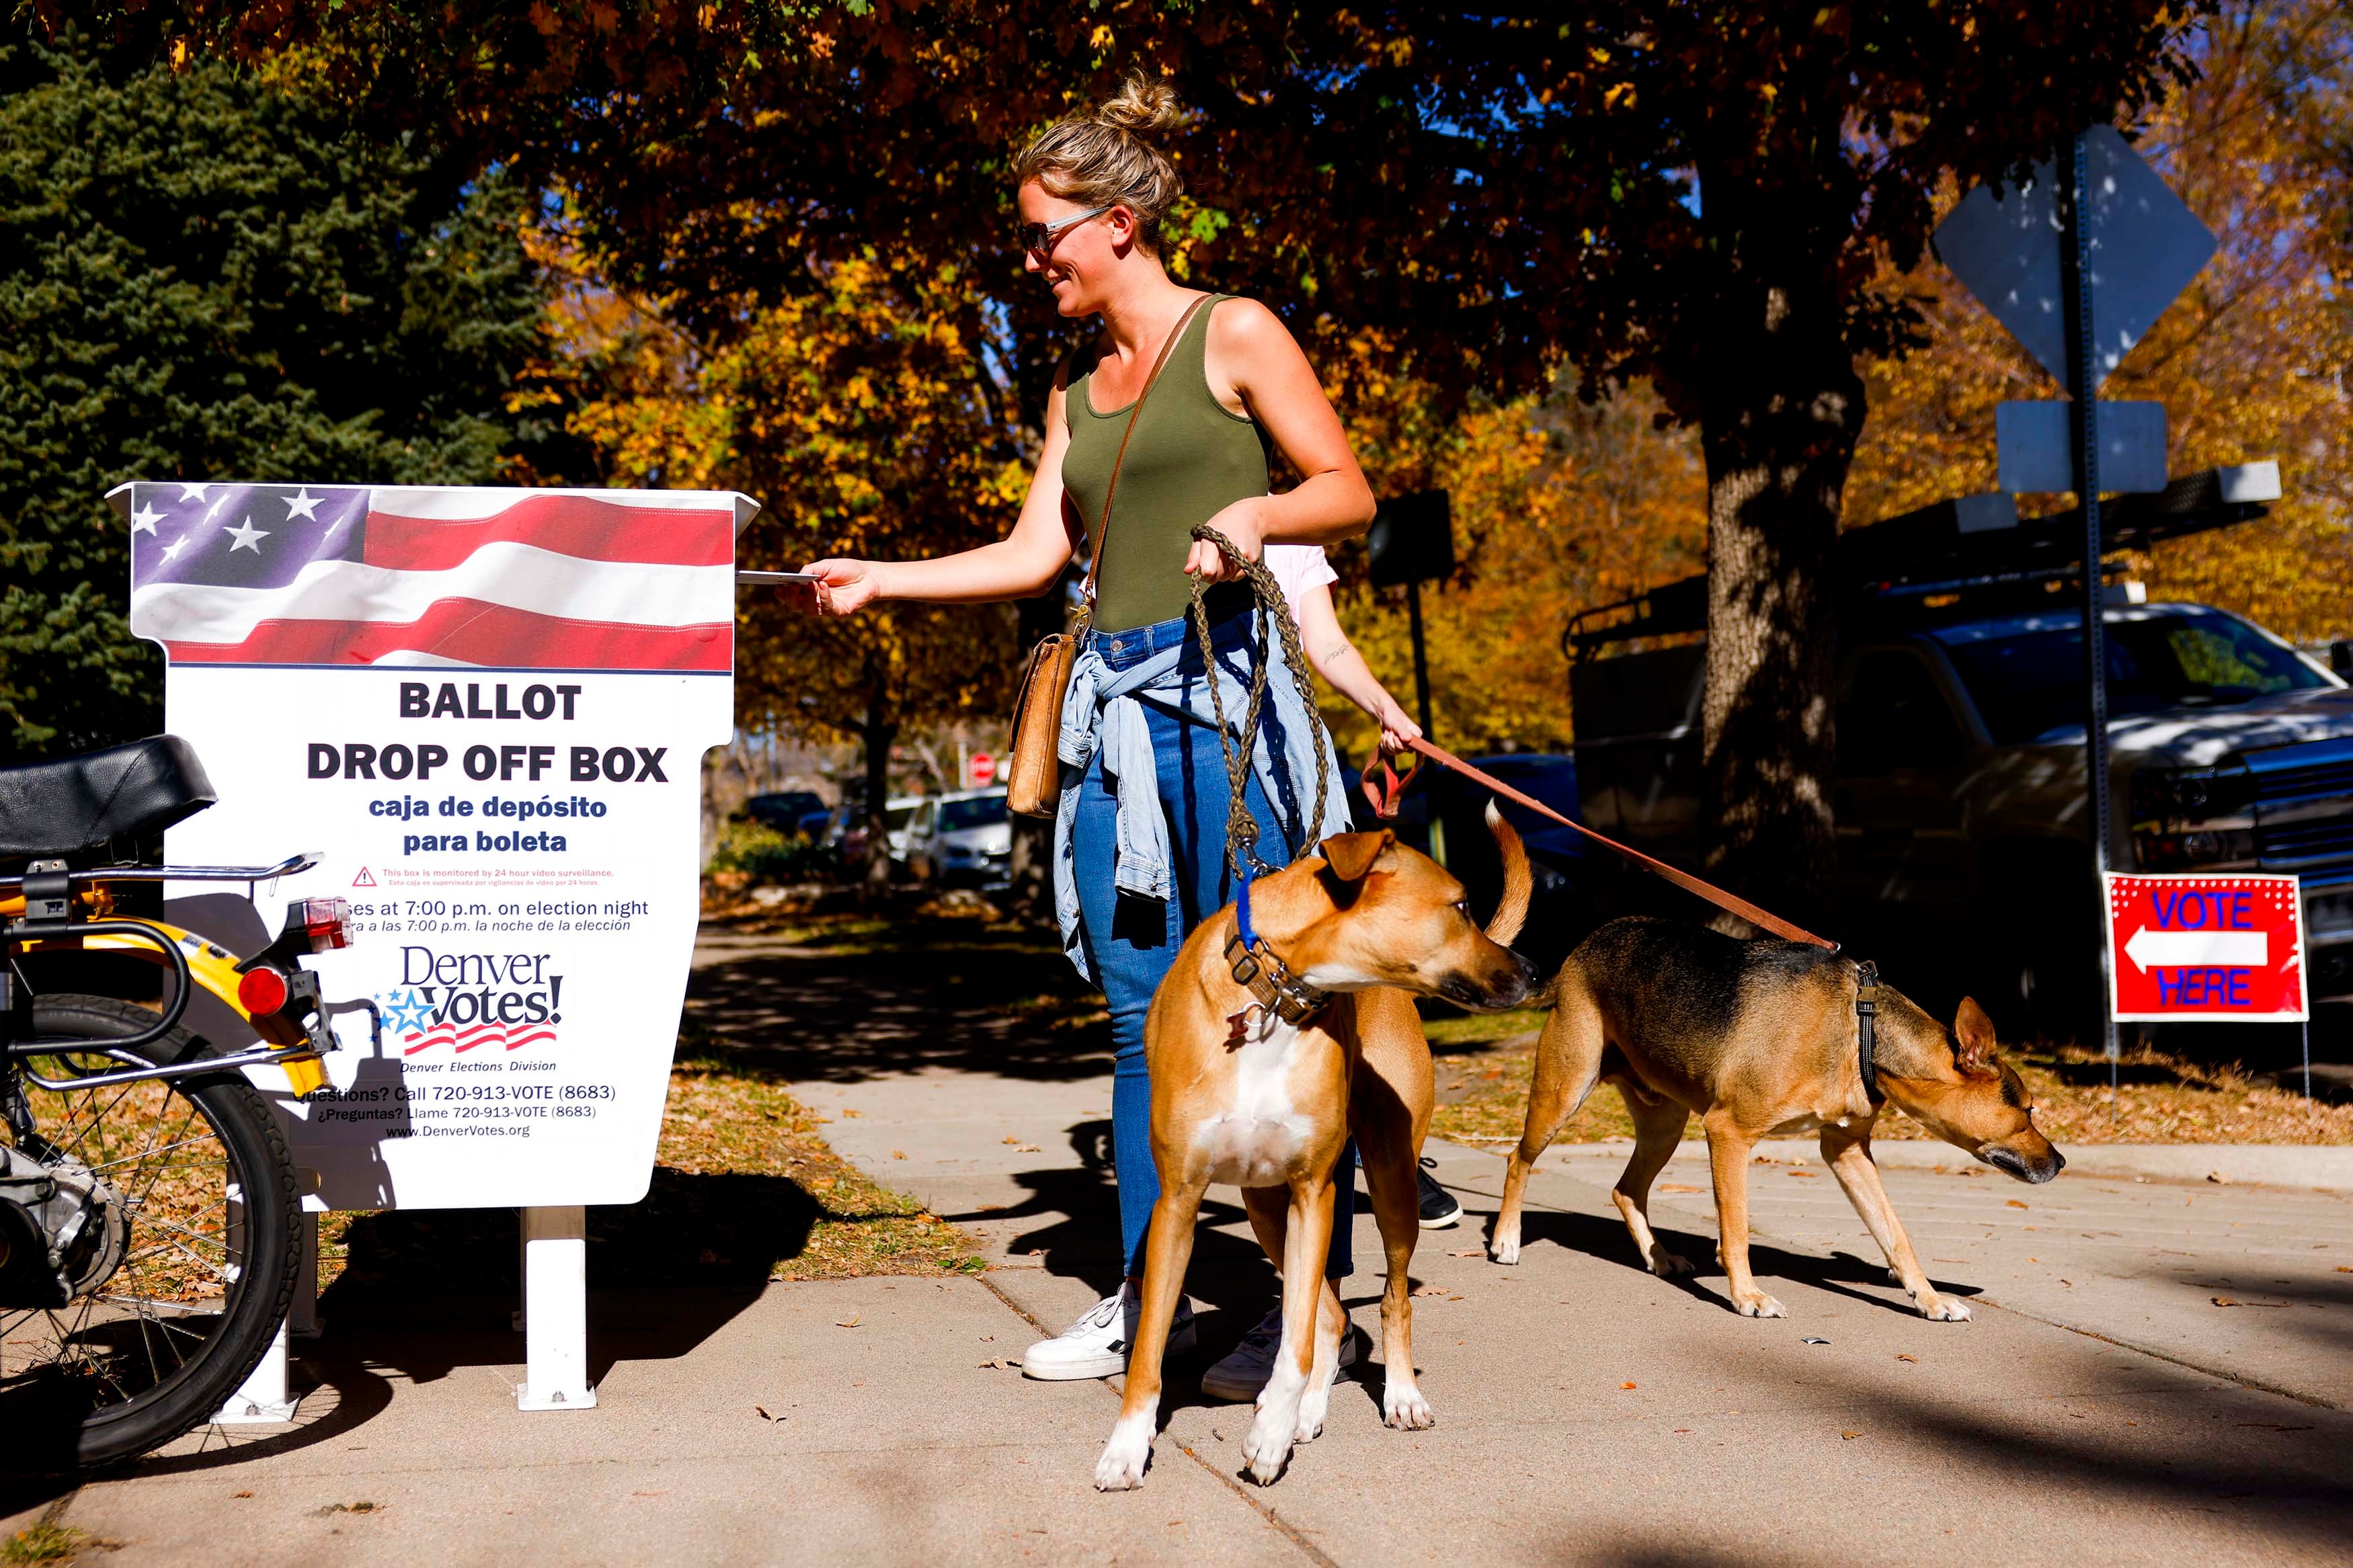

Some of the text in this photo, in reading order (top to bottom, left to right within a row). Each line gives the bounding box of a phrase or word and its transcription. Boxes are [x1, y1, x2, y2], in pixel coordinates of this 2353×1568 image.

[400, 682, 582, 720] BALLOT
[308, 743, 669, 782] DROP OFF BOX
[369, 795, 606, 821] caja de depósito
[404, 831, 566, 856] para boleta
[482, 870, 492, 878] by
[558, 869, 614, 877] surveillance.
[381, 902, 398, 915] at
[405, 901, 445, 915] 7:00
[453, 905, 491, 919] p.m.
[499, 905, 519, 915] on
[527, 901, 596, 915] election
[604, 901, 649, 919] night
[2152, 892, 2252, 929] VOTE
[369, 923, 376, 932] a
[382, 920, 401, 932] las
[407, 920, 437, 932] 7:00
[441, 923, 469, 934] p.m.
[476, 920, 487, 931] la
[492, 920, 532, 931] noche
[538, 920, 553, 931] de
[559, 920, 569, 931] la
[575, 919, 631, 931] elección
[400, 946, 550, 985] Denver
[2156, 968, 2251, 1005] HERE
[419, 975, 563, 1025] Votes!
[400, 1061, 557, 1073] Denver Elections Division
[293, 1085, 616, 1104] Questions? Call 720-913-VOTE (8683)
[318, 1106, 596, 1122] ¿Preguntas? Llame 720-913-VOTE (8683)
[387, 1125, 530, 1138] www.DenverVotes.org
